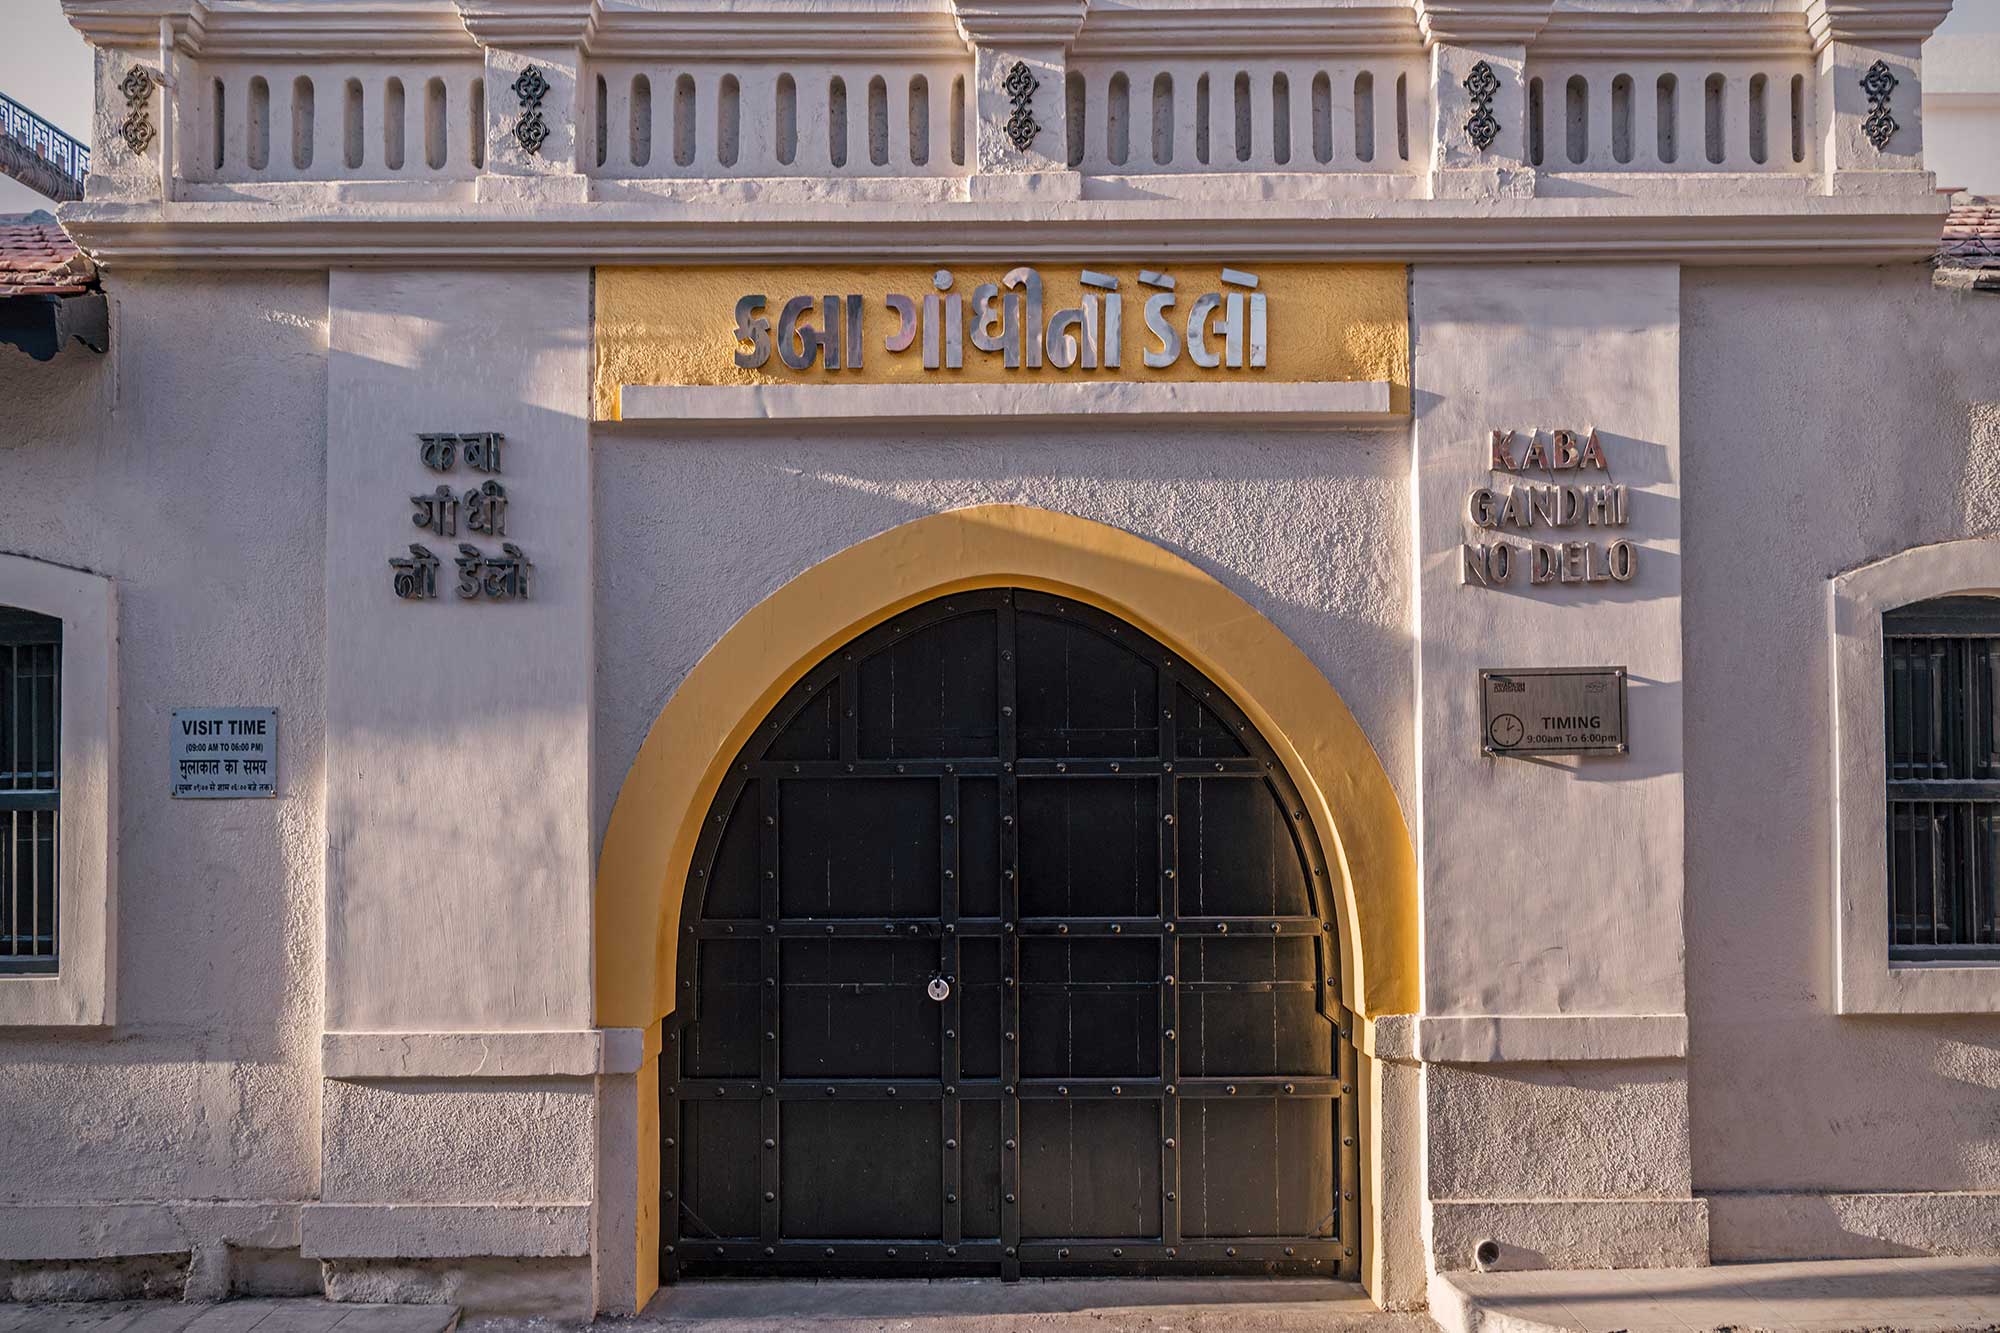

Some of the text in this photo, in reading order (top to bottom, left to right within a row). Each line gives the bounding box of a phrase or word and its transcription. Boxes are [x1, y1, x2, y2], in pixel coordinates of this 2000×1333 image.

[734, 294, 863, 369] કબા
[1137, 267, 1267, 369] ડેલો
[416, 432, 505, 473] कबा
[1489, 426, 1608, 471] KABA
[410, 480, 508, 536] गांधी
[1469, 484, 1630, 527] GANDHI
[388, 543, 533, 599] नो डेलो
[1460, 538, 1638, 586] NO DELO
[182, 720, 266, 735] VISIT TIME
[1526, 733, 1617, 744] 9:00am To 6:00pm
[1541, 716, 1601, 730] TIMING
[208, 743, 219, 752] AM
[220, 743, 230, 752] TO
[230, 743, 249, 752] 06:00
[179, 759, 268, 781] मुलाकात का समय
